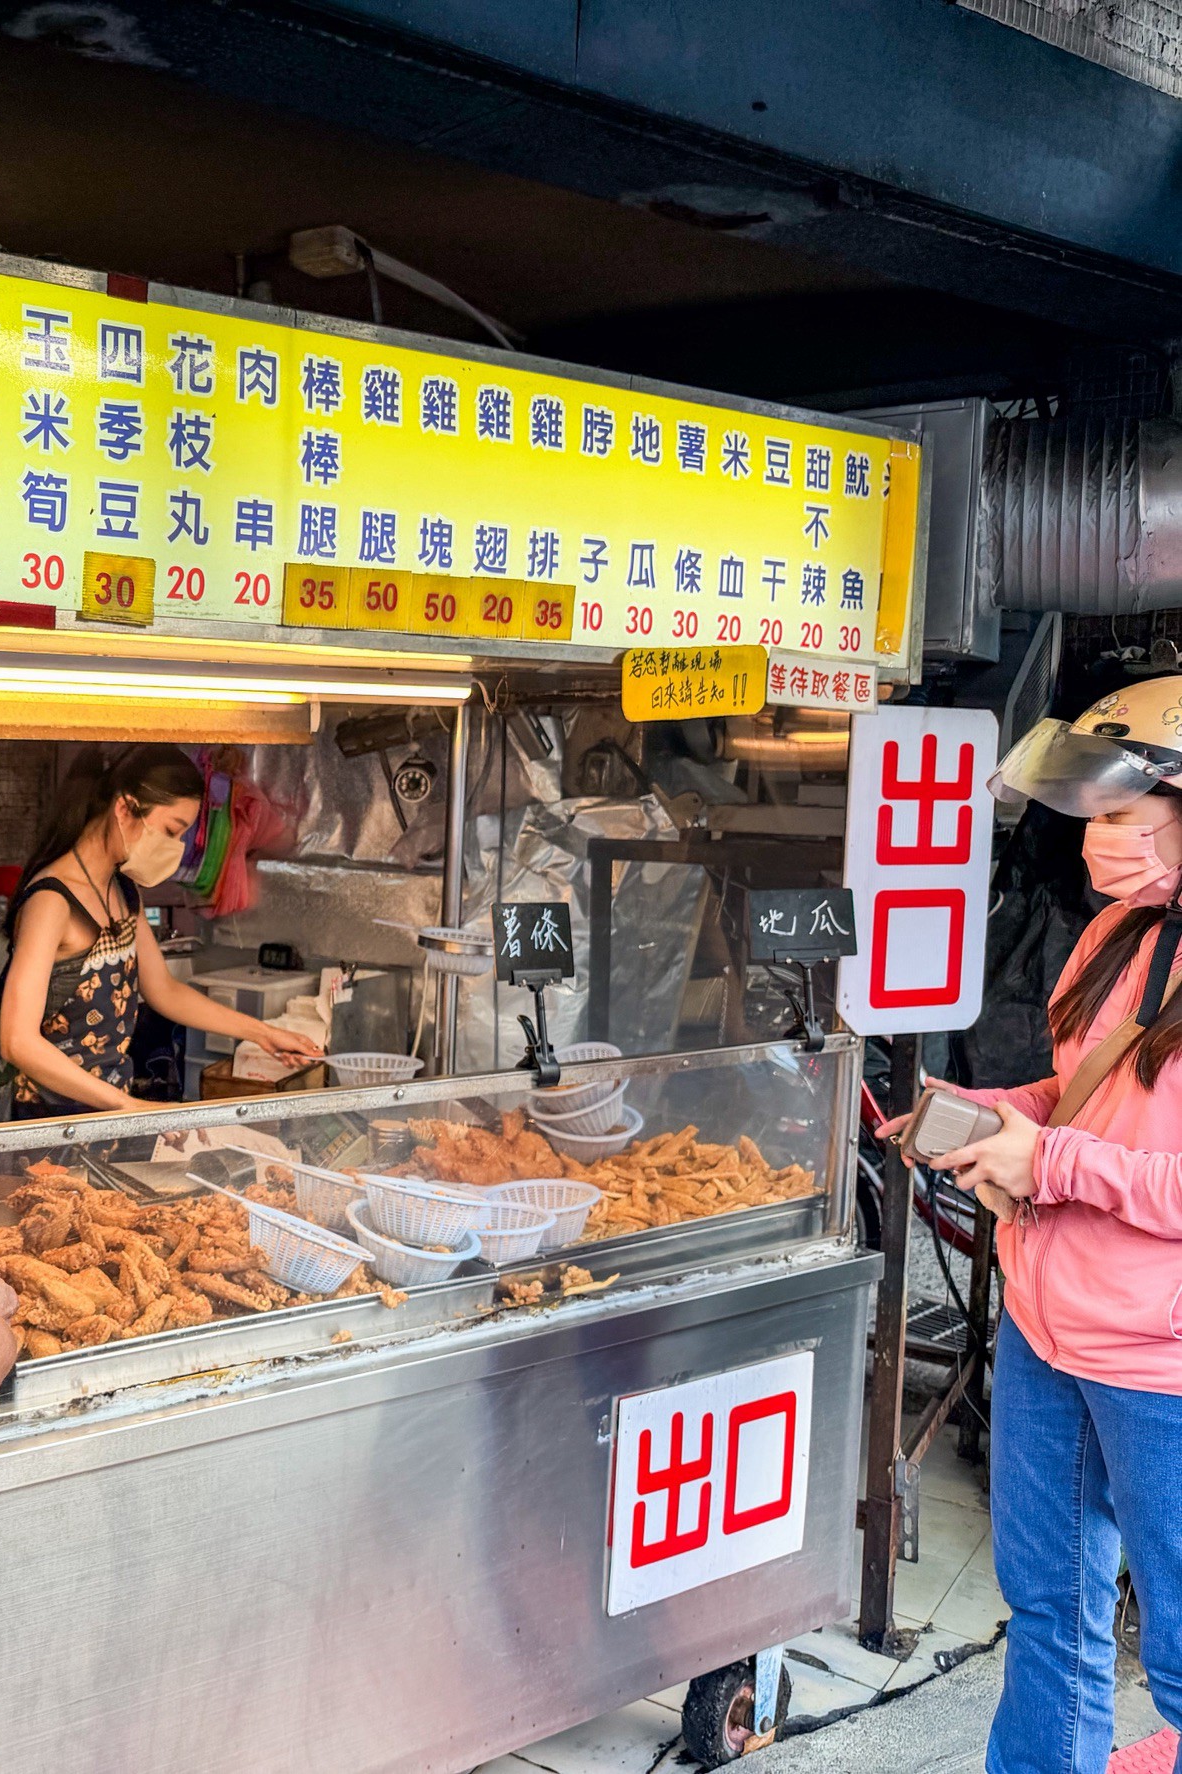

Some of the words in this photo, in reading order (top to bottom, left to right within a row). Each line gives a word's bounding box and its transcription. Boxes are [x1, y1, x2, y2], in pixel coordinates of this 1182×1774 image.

[22, 310, 69, 532] 玉米筍
[97, 324, 141, 539] 四季豆
[169, 337, 212, 545] 花枝丸
[235, 350, 276, 550] 肉串
[297, 361, 340, 558] 棒棒腿
[359, 370, 399, 564] 雞腿
[418, 380, 456, 569] 雞塊
[474, 389, 510, 574] 雞翅
[527, 399, 562, 578] 雞排
[580, 409, 613, 583] 脖子
[626, 420, 659, 588] 地瓜
[675, 425, 705, 593] 薯條
[719, 437, 748, 598] 米血
[763, 441, 790, 600] 豆干
[802, 449, 830, 606] 甜不辣
[842, 455, 869, 609] 魷魚
[21, 553, 65, 590] 30
[94, 572, 135, 607] 30
[167, 565, 205, 601] 20
[234, 571, 271, 606] 20
[299, 578, 334, 611] 35
[366, 581, 398, 612] 50
[424, 593, 456, 623] 50
[482, 593, 513, 624] 20
[535, 599, 563, 630] 35
[581, 602, 603, 631] 10
[626, 606, 653, 635] 30
[672, 610, 698, 638] 30
[717, 614, 741, 642] 20
[759, 618, 783, 645] 20
[800, 622, 823, 649] 20
[839, 626, 861, 652] 30
[769, 663, 871, 703] 等待取餐區
[869, 733, 975, 1010] 出口
[500, 907, 569, 959] 薯條
[759, 899, 850, 937] 地瓜
[630, 1390, 797, 1569] 出口
